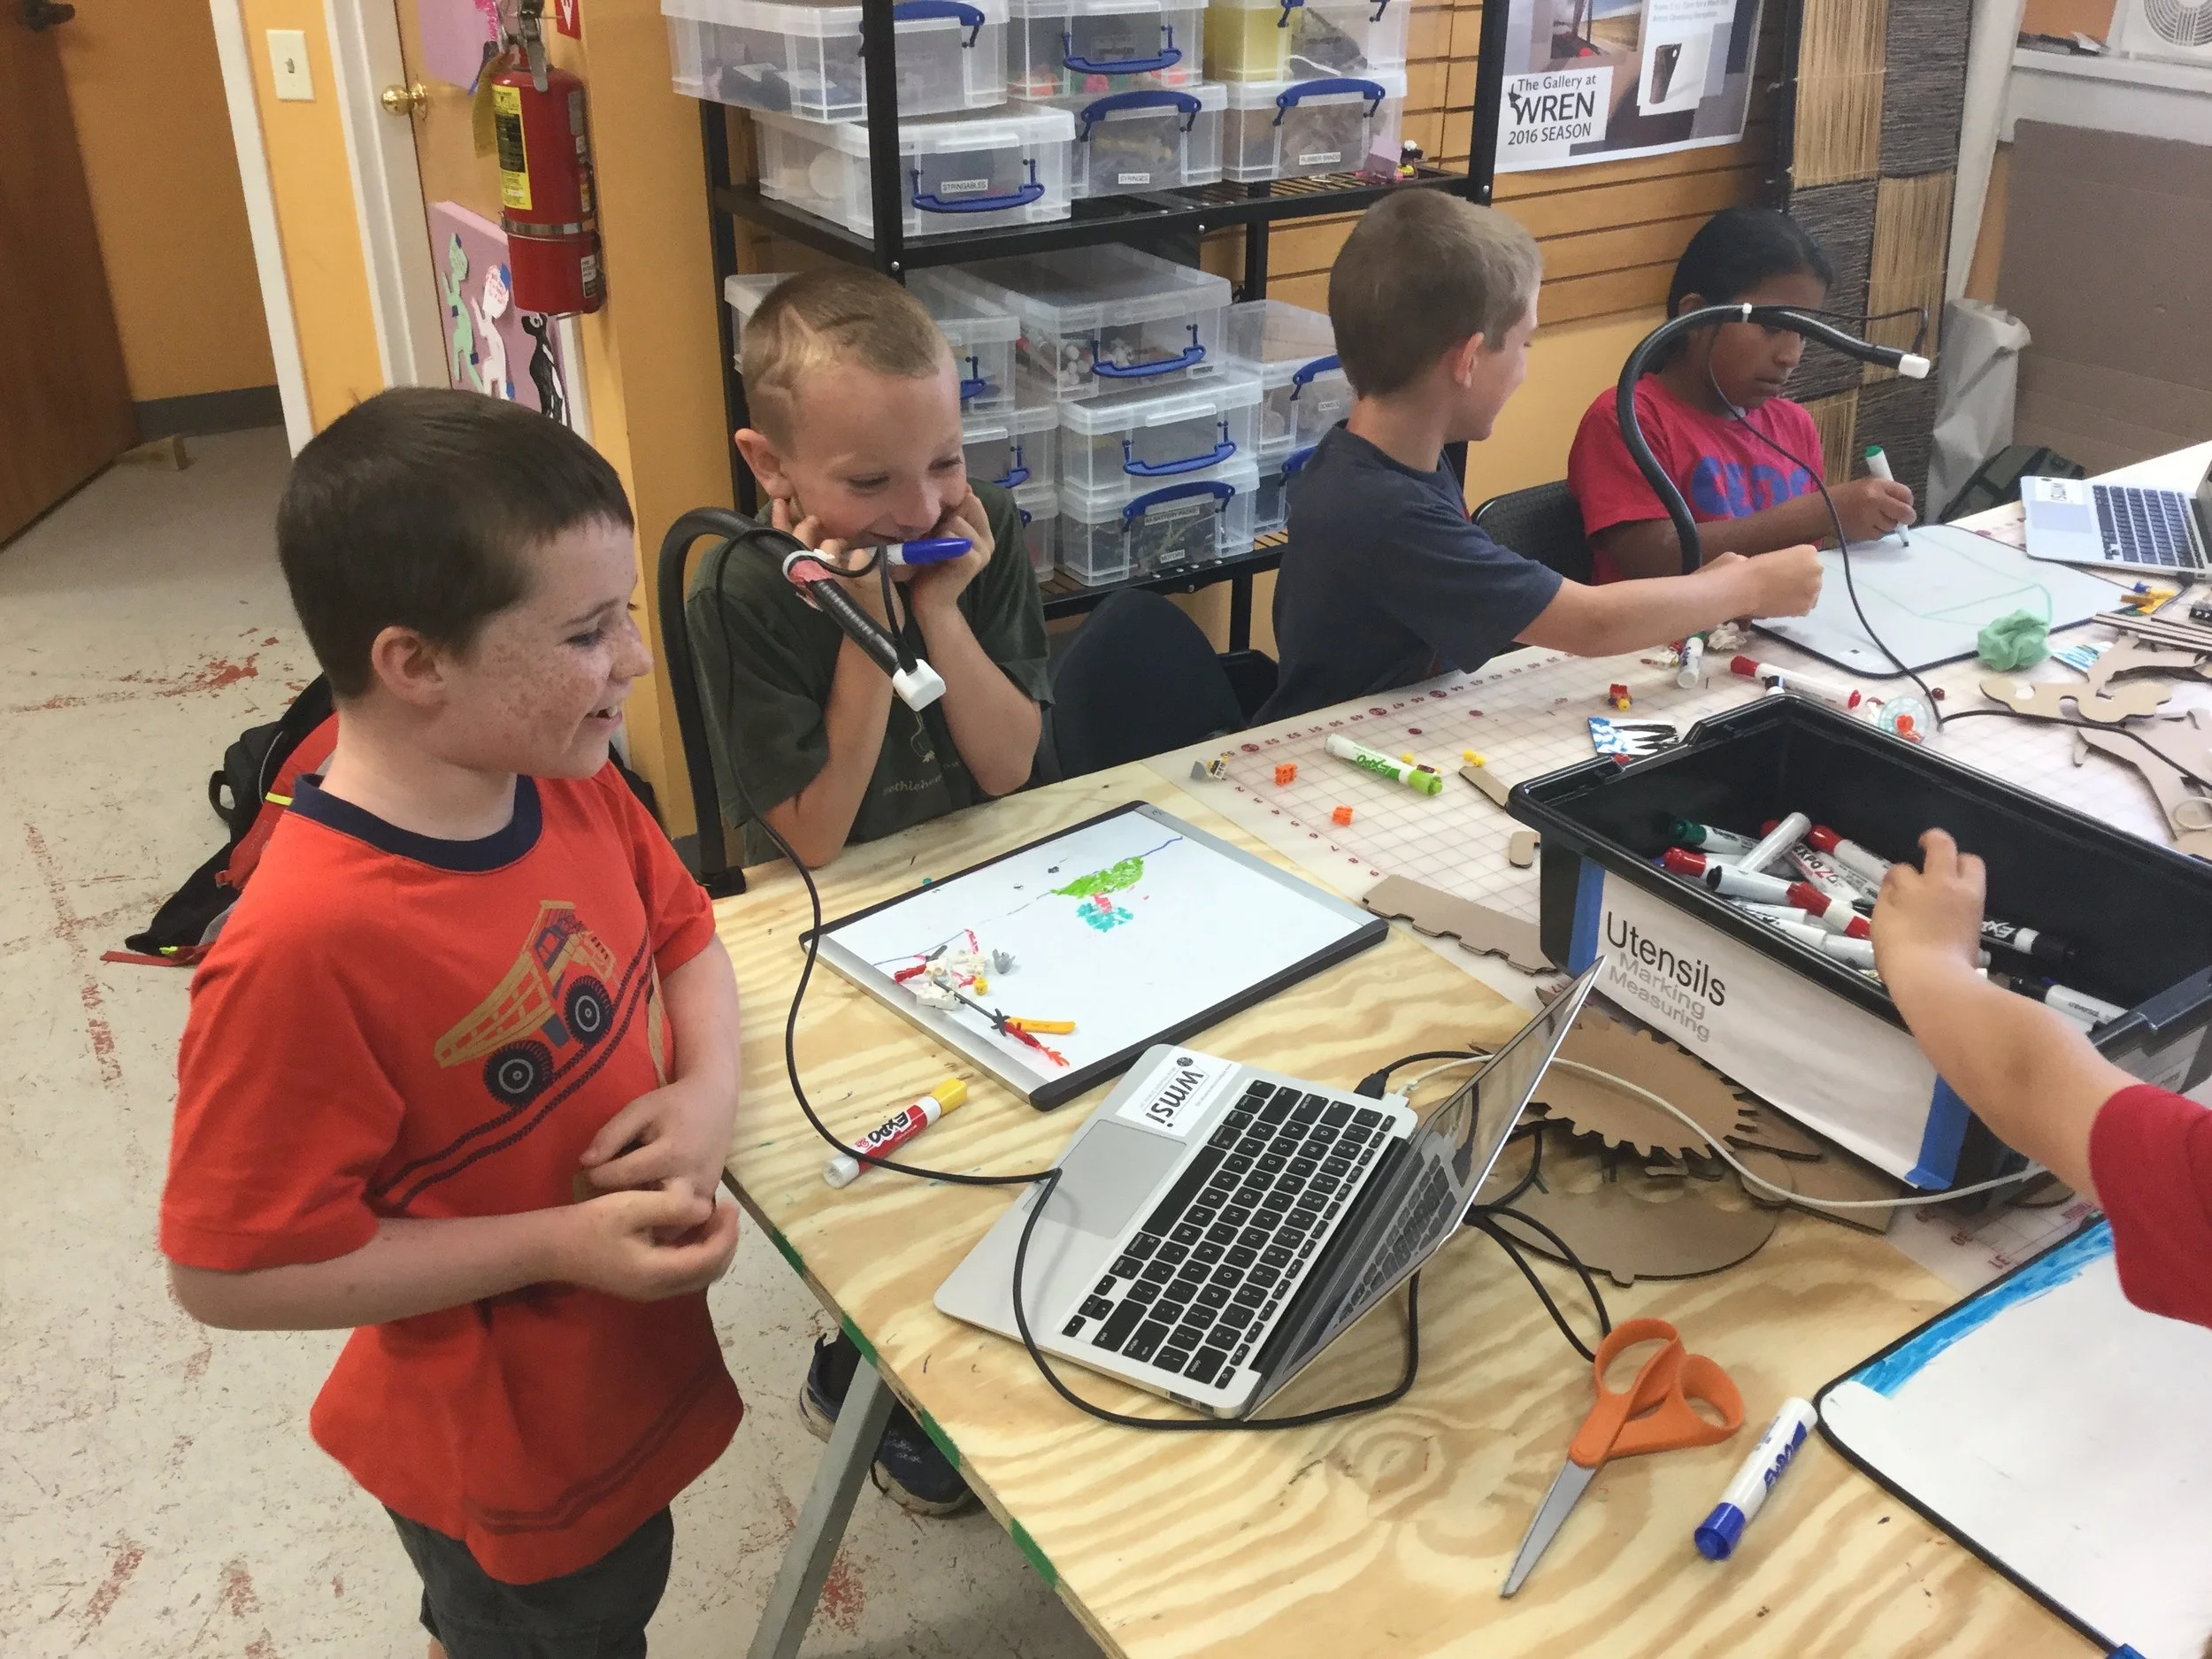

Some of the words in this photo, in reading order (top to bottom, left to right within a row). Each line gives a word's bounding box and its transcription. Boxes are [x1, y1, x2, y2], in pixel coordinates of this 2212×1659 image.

[1517, 78, 1539, 92] The
[1543, 75, 1582, 90] Gallery
[1586, 74, 1596, 85] at
[1509, 90, 1595, 125] WREN
[1508, 129, 1538, 145] 2016
[1541, 123, 1591, 142] SEASON
[1793, 843, 1824, 869] EXPO
[1607, 911, 1726, 1007] Utensils
[1609, 965, 1710, 1043] Measuring
[1619, 952, 1706, 1021] Marking
[1145, 1070, 1204, 1128] wmsi
[868, 1111, 910, 1144] EXPO
